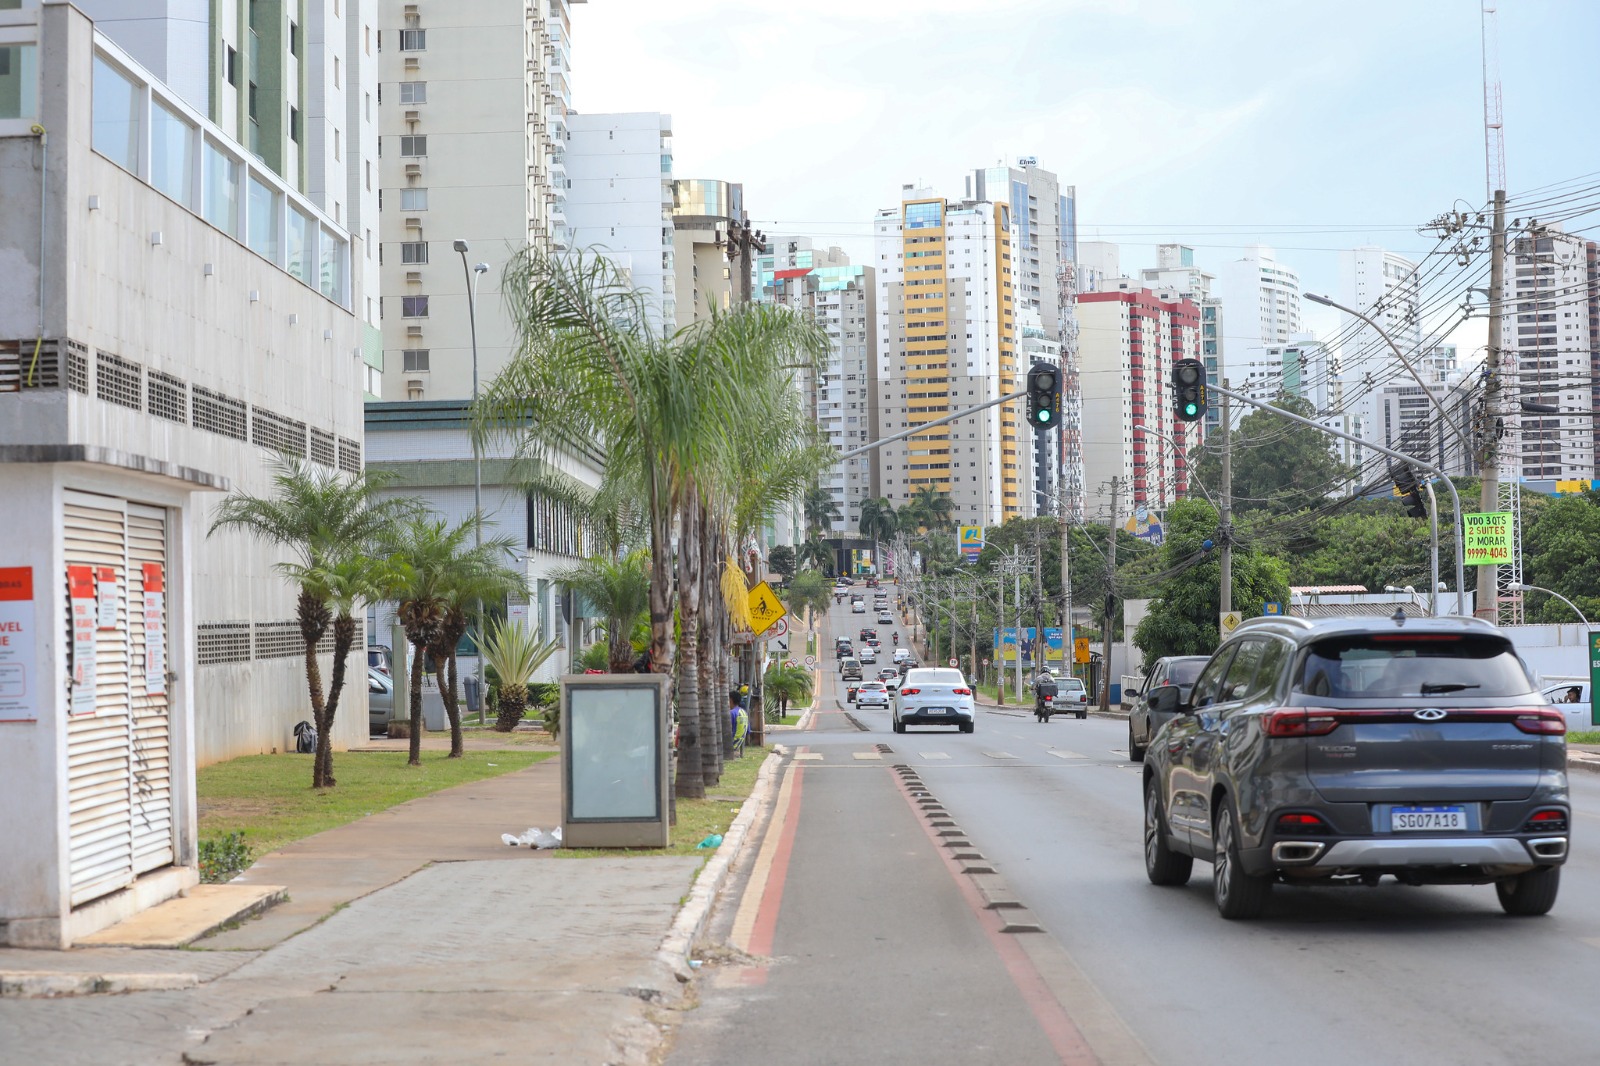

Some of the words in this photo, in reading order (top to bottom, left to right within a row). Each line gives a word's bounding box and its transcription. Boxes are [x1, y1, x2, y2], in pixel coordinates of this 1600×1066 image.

[1466, 516, 1484, 526] VDO
[1468, 526, 1475, 535] 2
[1476, 526, 1506, 535] SUITES
[1477, 536, 1506, 546] MORAR
[1467, 547, 1508, 559] 99999-4043
